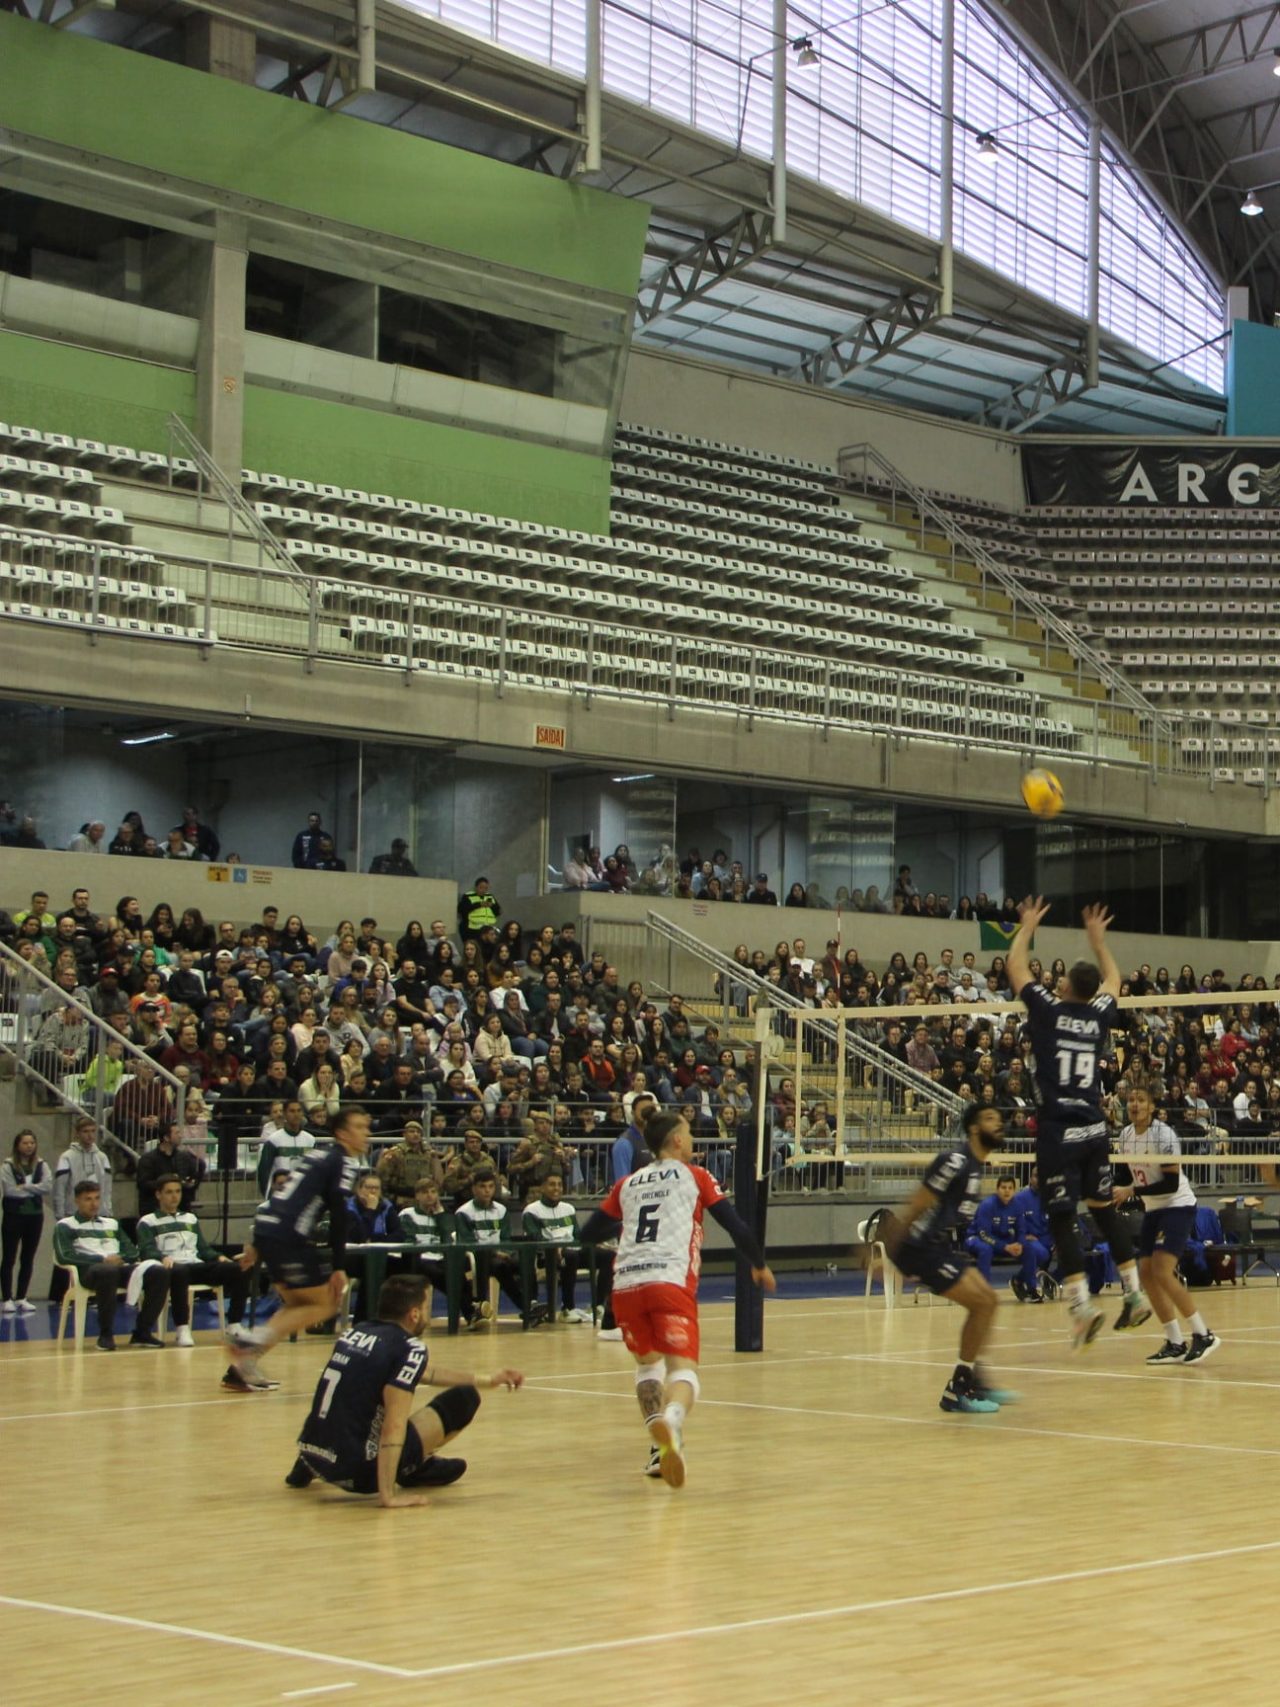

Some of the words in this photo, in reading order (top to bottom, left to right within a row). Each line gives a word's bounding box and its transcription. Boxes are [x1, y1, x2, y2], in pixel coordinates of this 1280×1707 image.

[1056, 1015, 1101, 1035] ELEVA
[1056, 1050, 1095, 1089] 19
[629, 1168, 680, 1188] ELEVA
[635, 1203, 661, 1243] 6
[319, 1367, 341, 1419] 7
